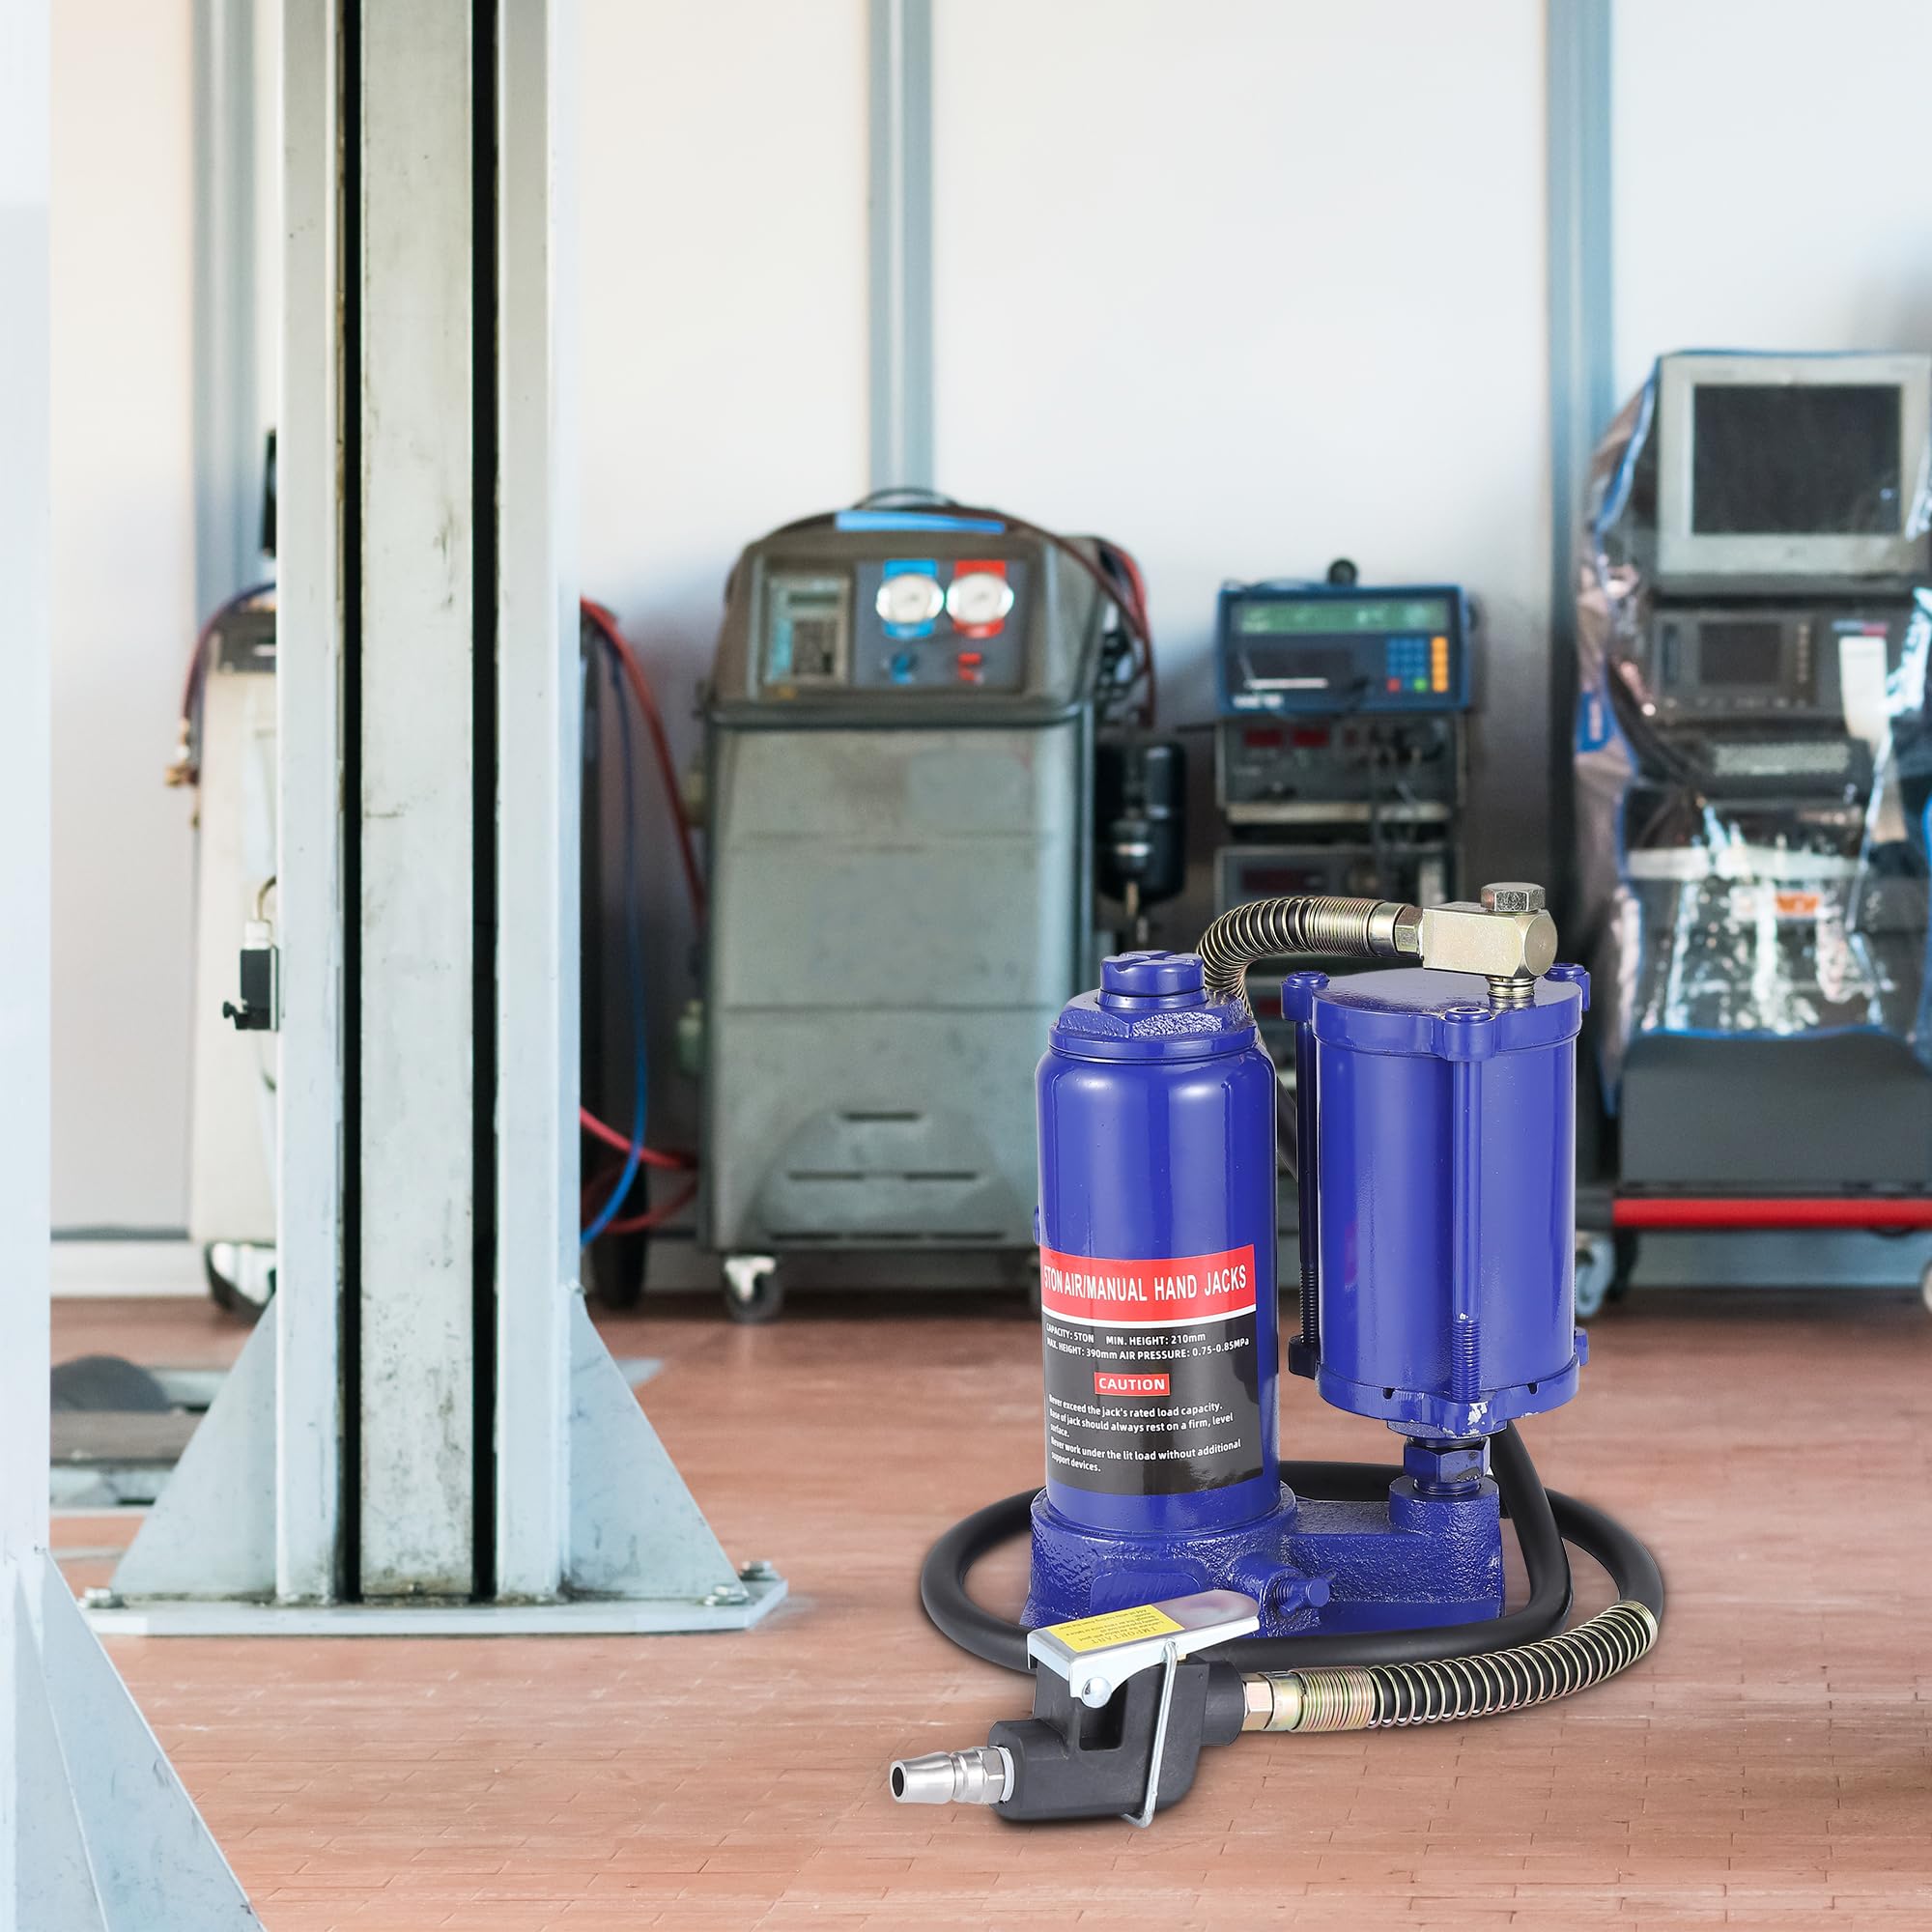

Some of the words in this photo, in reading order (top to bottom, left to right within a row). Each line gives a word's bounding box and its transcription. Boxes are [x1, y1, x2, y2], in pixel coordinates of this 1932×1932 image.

[1065, 1271, 1148, 1301] AIR/MANUAL
[1154, 1274, 1197, 1301] HAND
[1204, 1264, 1246, 1296] JACKS
[1046, 1322, 1072, 1339] CAPACITY:
[1073, 1332, 1094, 1343] 5TON
[1106, 1336, 1127, 1346] MIN.
[1129, 1336, 1169, 1346] HEIGHT:
[1171, 1333, 1206, 1345] 210mm
[1059, 1342, 1085, 1356] HEIGHT:
[1086, 1348, 1118, 1360] 390mm
[1119, 1351, 1136, 1360] AIR
[1137, 1350, 1190, 1360] PRESSURE:
[1192, 1338, 1249, 1356] 0.75-0.85MPa
[1098, 1378, 1165, 1391] CAUTION
[1063, 1401, 1087, 1413] exceed
[1087, 1405, 1101, 1415] the
[1101, 1406, 1128, 1418] jack's
[1129, 1407, 1155, 1418] rated
[1157, 1406, 1179, 1417] load
[1180, 1402, 1223, 1416] capacity.
[1066, 1414, 1081, 1425] jack
[1081, 1419, 1109, 1430] should
[1110, 1422, 1144, 1434] always
[1146, 1423, 1165, 1432] rest
[1188, 1419, 1210, 1429] firm,
[1212, 1412, 1234, 1425] level
[1065, 1445, 1081, 1455] work
[1081, 1448, 1105, 1458] under
[1106, 1450, 1122, 1460] the
[1122, 1451, 1133, 1460] lit
[1135, 1451, 1156, 1460] load
[1158, 1449, 1196, 1460] without
[1197, 1438, 1241, 1456] additional
[1070, 1458, 1101, 1472] devices.
